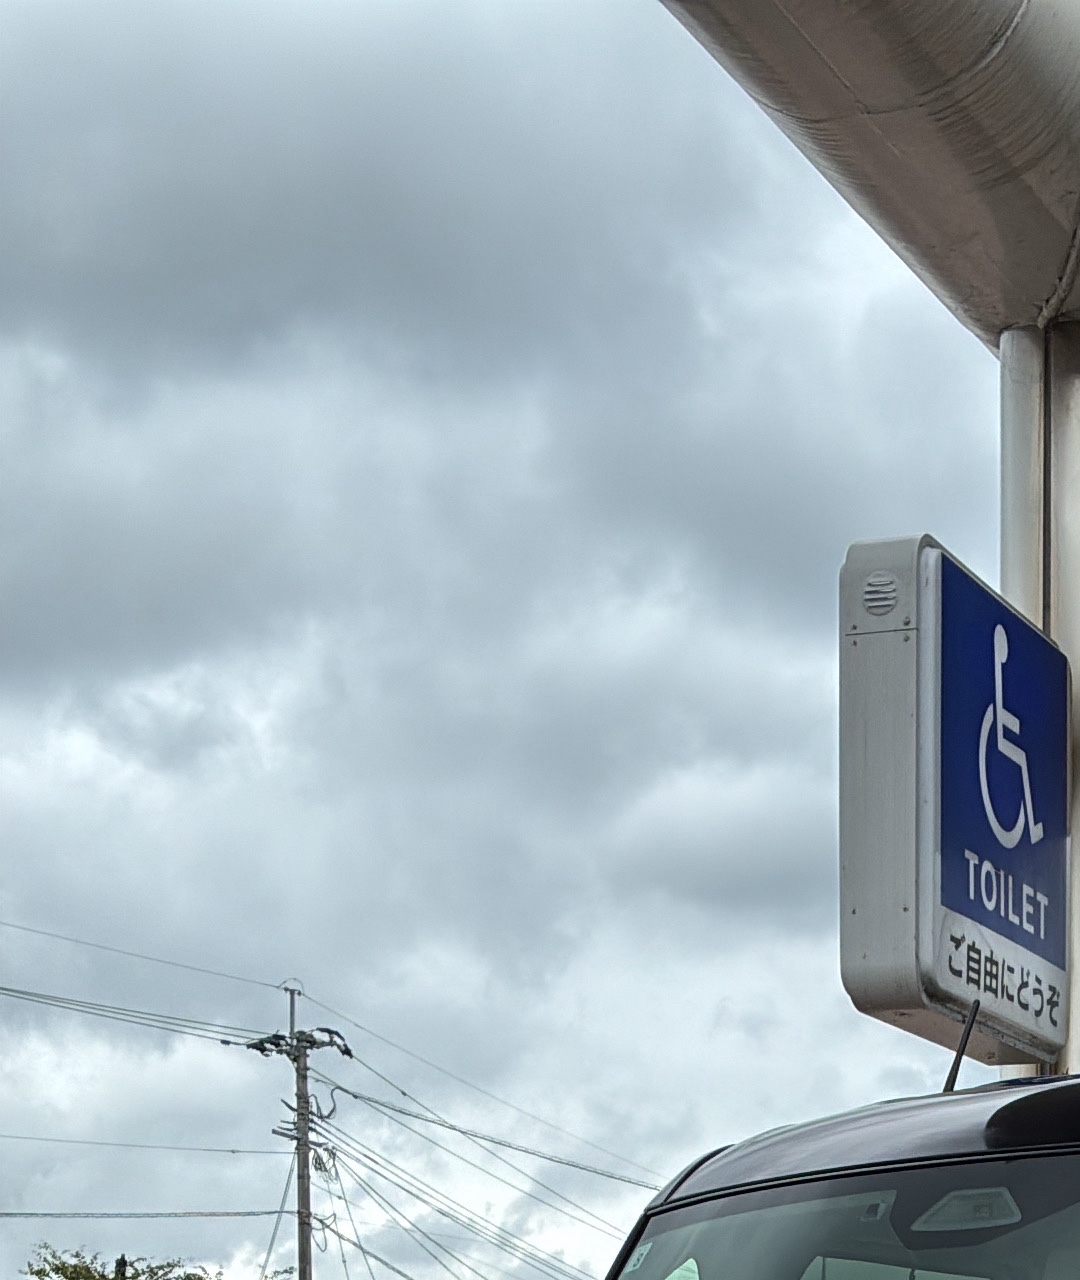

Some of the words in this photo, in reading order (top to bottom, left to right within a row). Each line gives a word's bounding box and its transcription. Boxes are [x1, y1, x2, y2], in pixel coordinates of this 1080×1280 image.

[964, 849, 1049, 940] TOILET
[948, 933, 1061, 1028] ご自由にどうぞ
